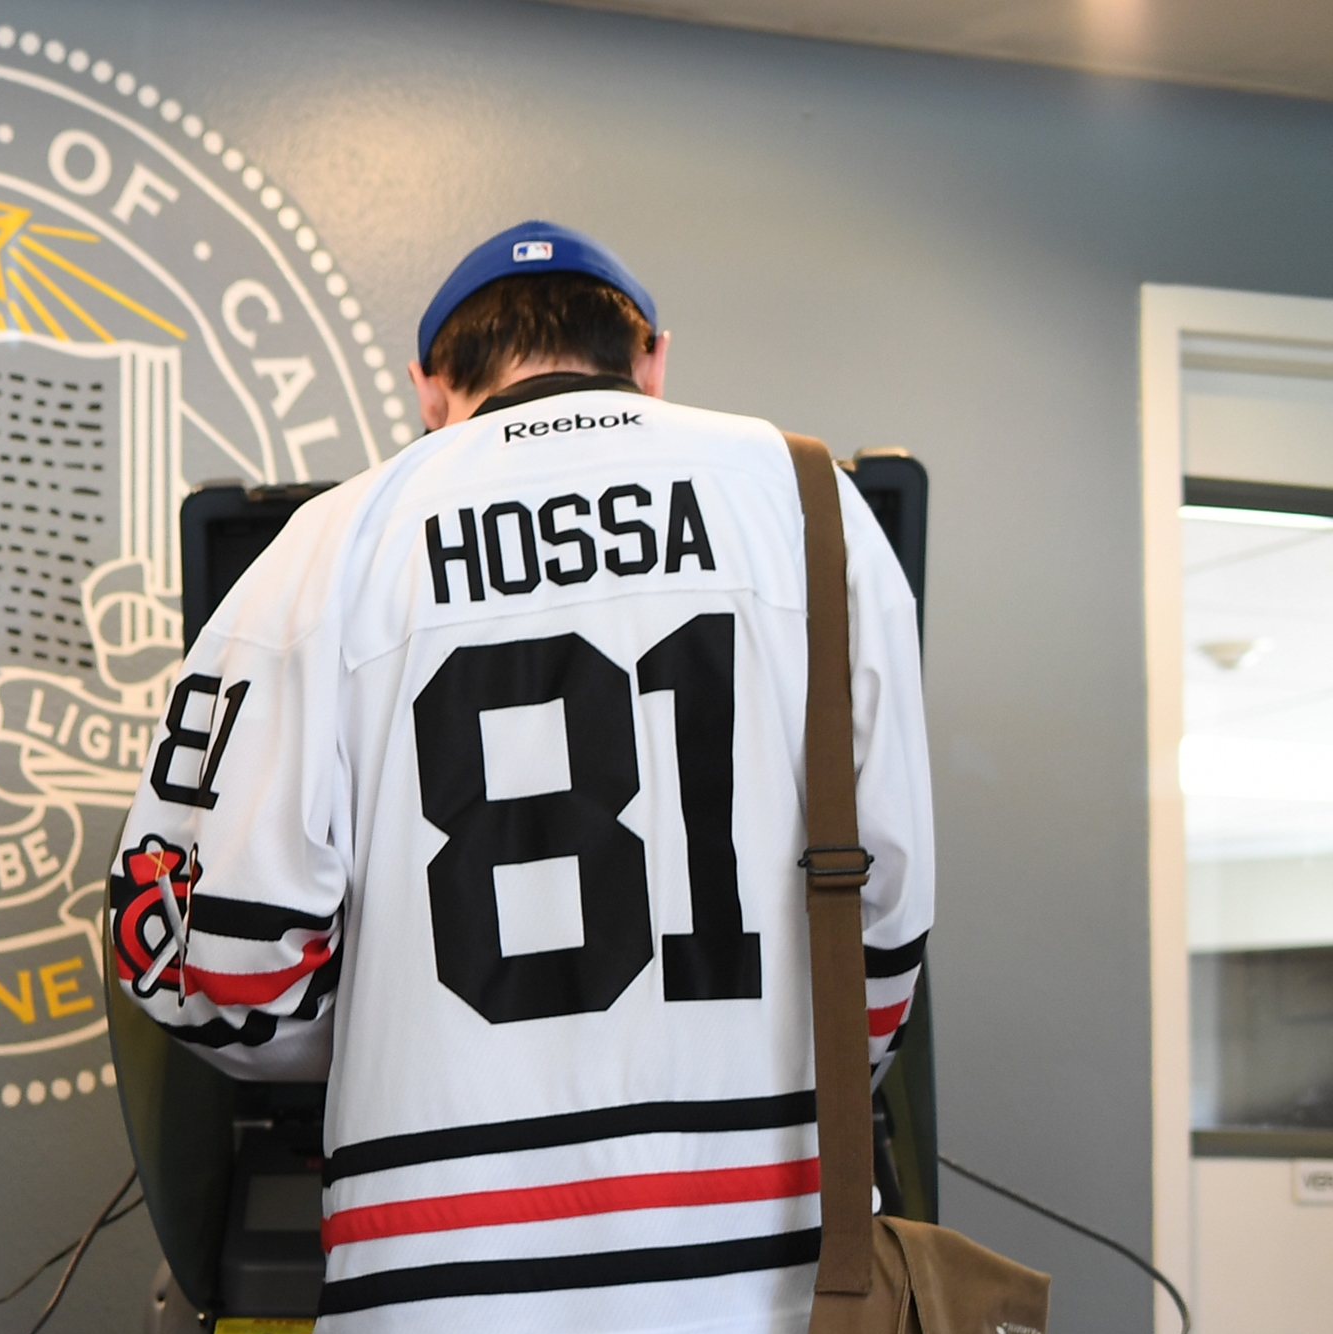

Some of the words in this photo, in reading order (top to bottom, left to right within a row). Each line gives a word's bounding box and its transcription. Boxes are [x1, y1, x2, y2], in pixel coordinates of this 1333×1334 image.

[48, 129, 180, 224] OF
[222, 279, 340, 482] CAL
[503, 411, 643, 443] Reebok
[425, 478, 716, 604] HOSSA
[26, 689, 157, 768] LIGH
[150, 673, 251, 810] 81
[413, 612, 762, 1024] 81
